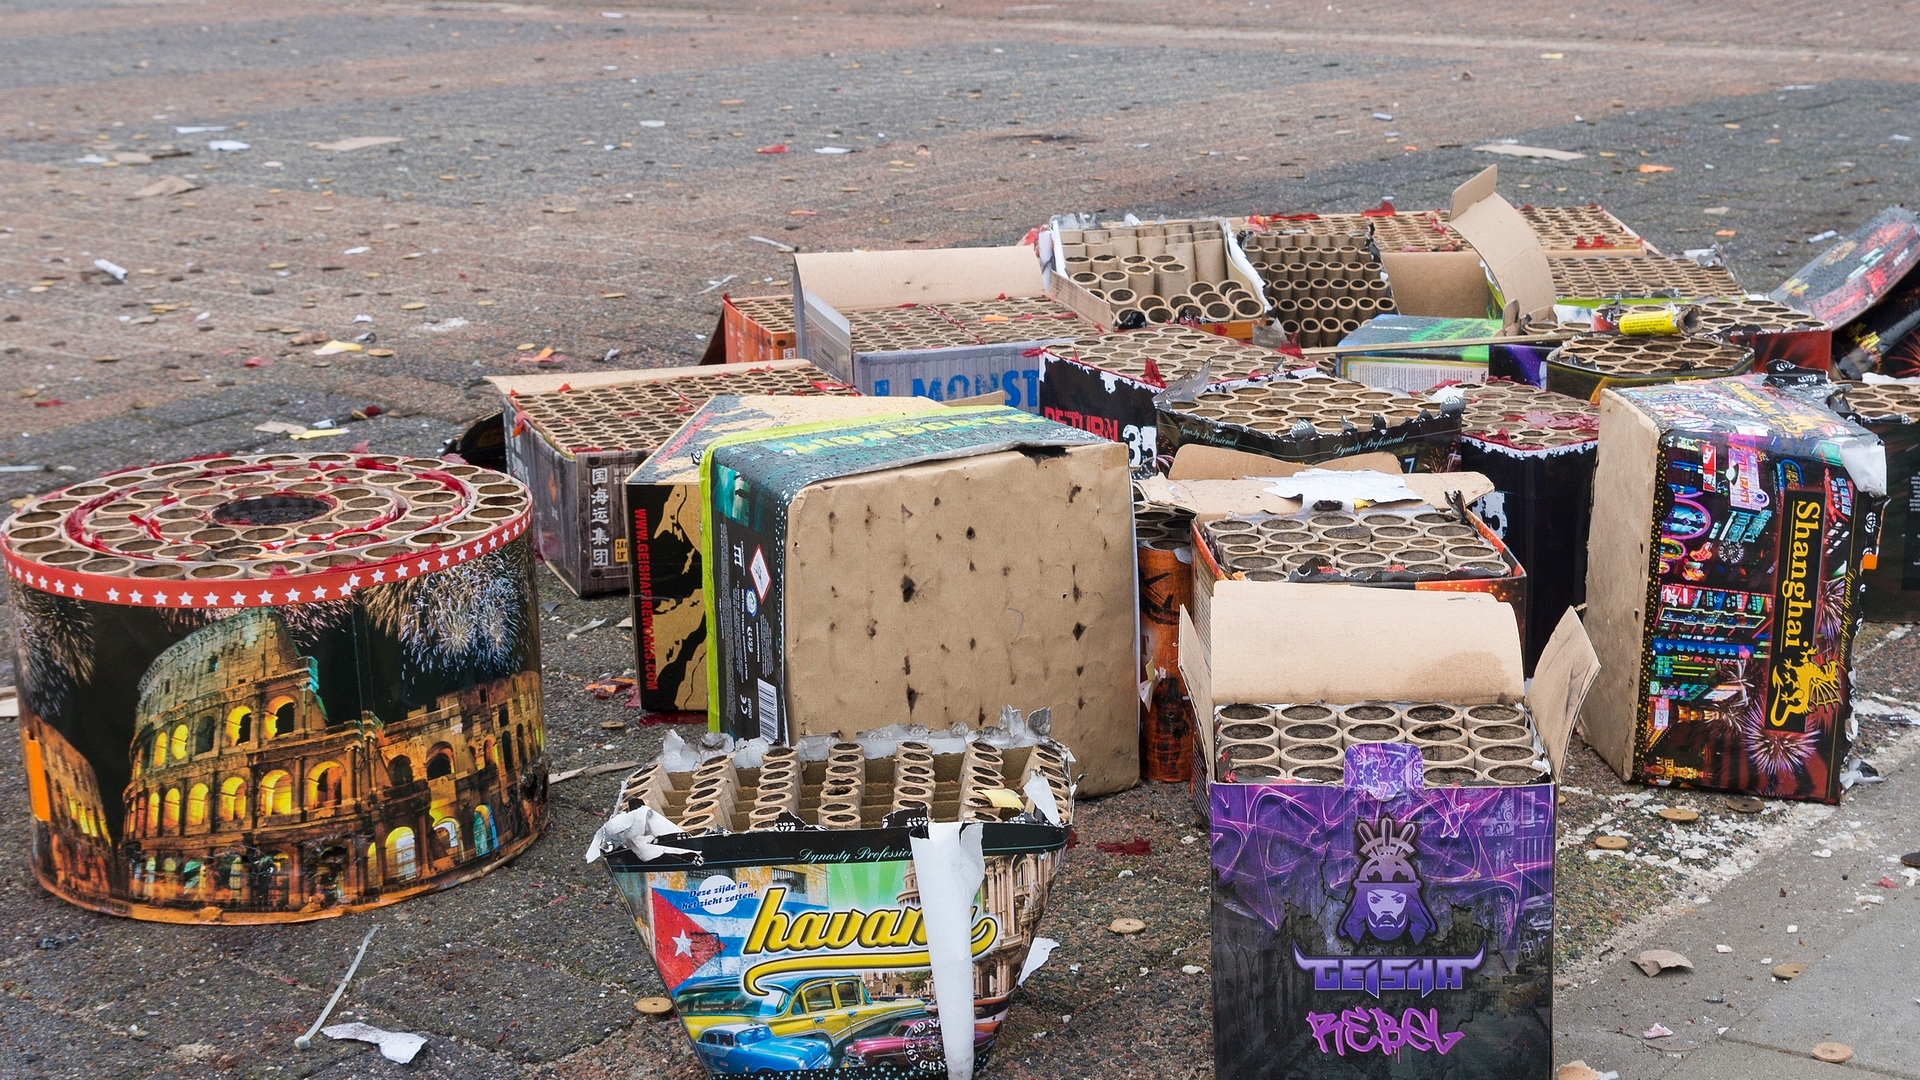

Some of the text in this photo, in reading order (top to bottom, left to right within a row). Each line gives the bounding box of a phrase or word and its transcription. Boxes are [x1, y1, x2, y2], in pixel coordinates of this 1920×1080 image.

[1363, 431, 1409, 450] Professional
[1781, 500, 1821, 648] Shanghai
[634, 508, 659, 691] WWW.GEISHAFIREWORKS.COM
[1840, 568, 1857, 673] Dynasty Professional
[798, 845, 914, 864] Dynasty Professio
[689, 881, 748, 898] Deze zijde in
[682, 890, 757, 910] het zicht zetten!
[1294, 942, 1486, 999] GEISHA
[913, 1021, 926, 1034] 49
[1305, 1006, 1466, 1062] REBEL
[905, 1043, 920, 1061] 265
[920, 1060, 947, 1071] GRA
